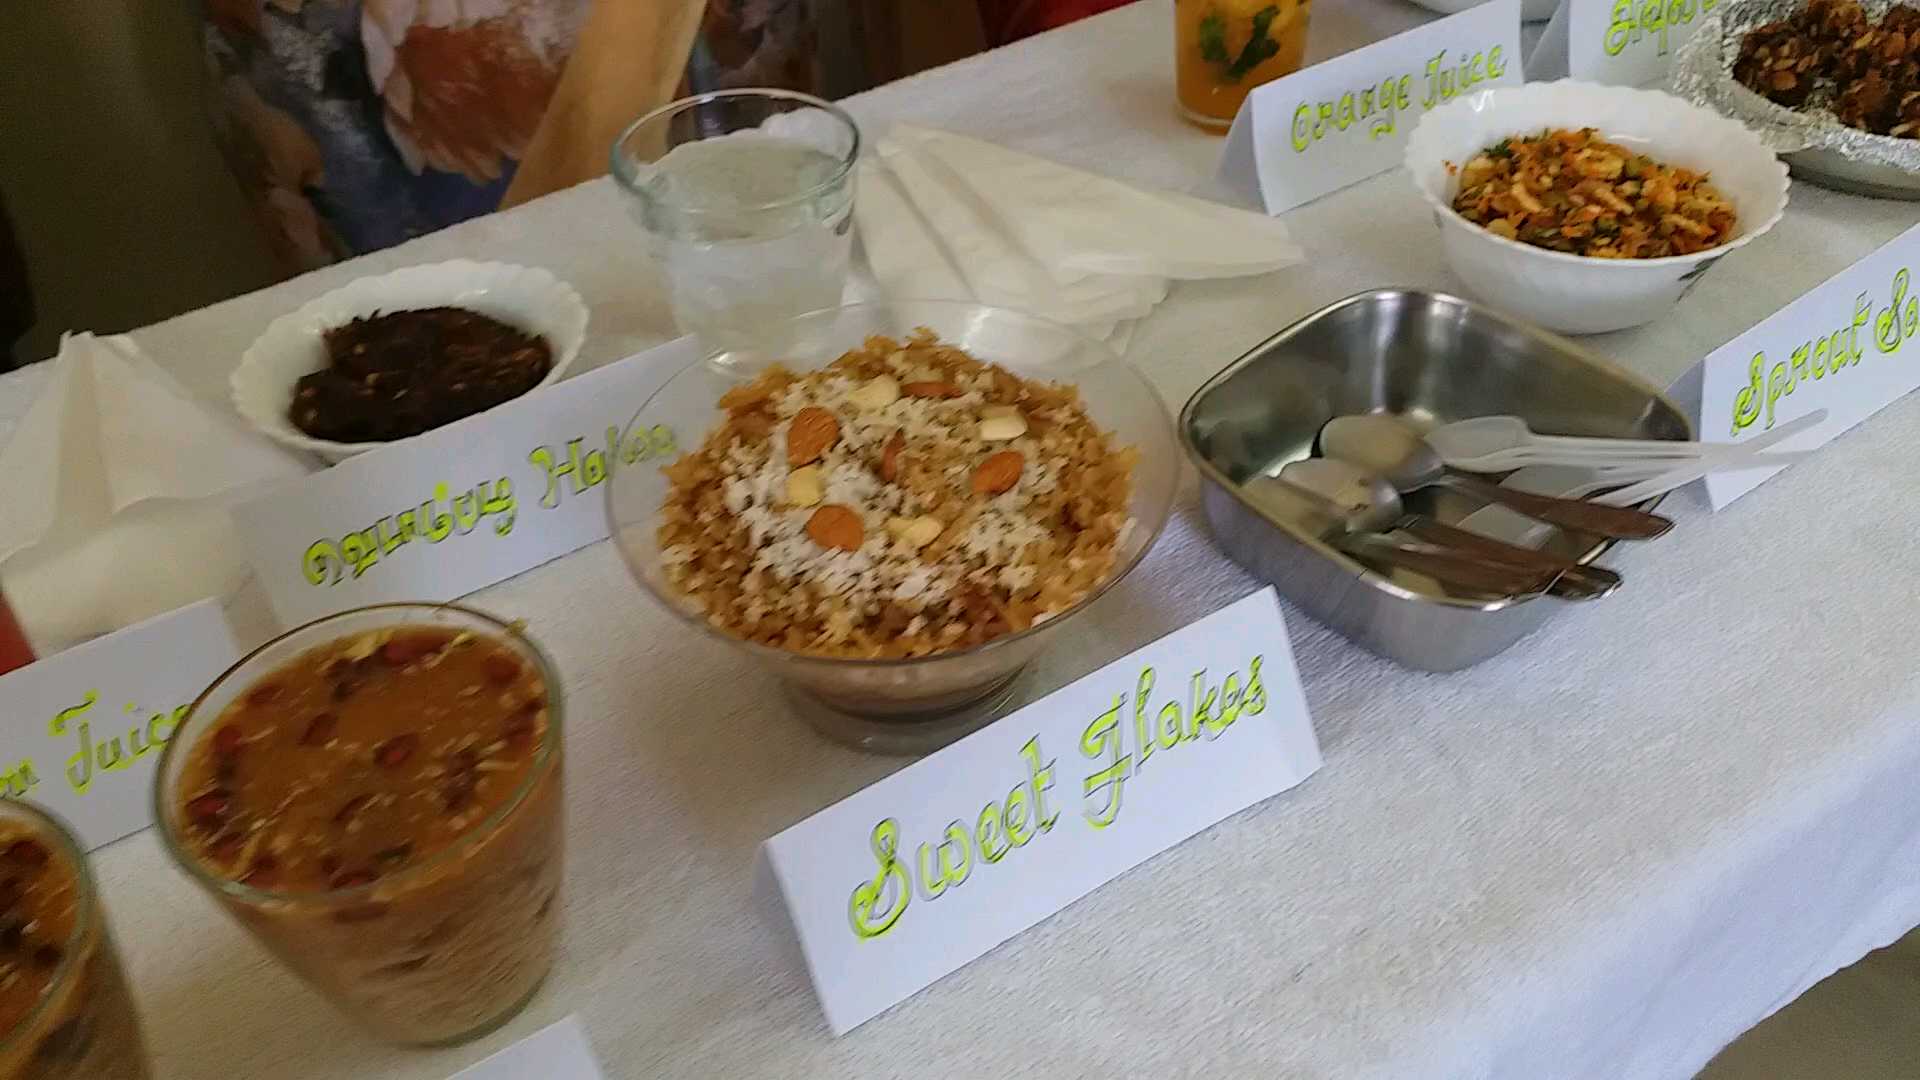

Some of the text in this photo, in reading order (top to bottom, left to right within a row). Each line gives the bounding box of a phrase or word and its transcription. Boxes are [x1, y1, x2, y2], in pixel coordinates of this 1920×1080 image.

[1291, 45, 1508, 152] Orange Juice
[1731, 290, 1873, 436] Sprout
[848, 654, 1268, 940] Sweet Flakes
